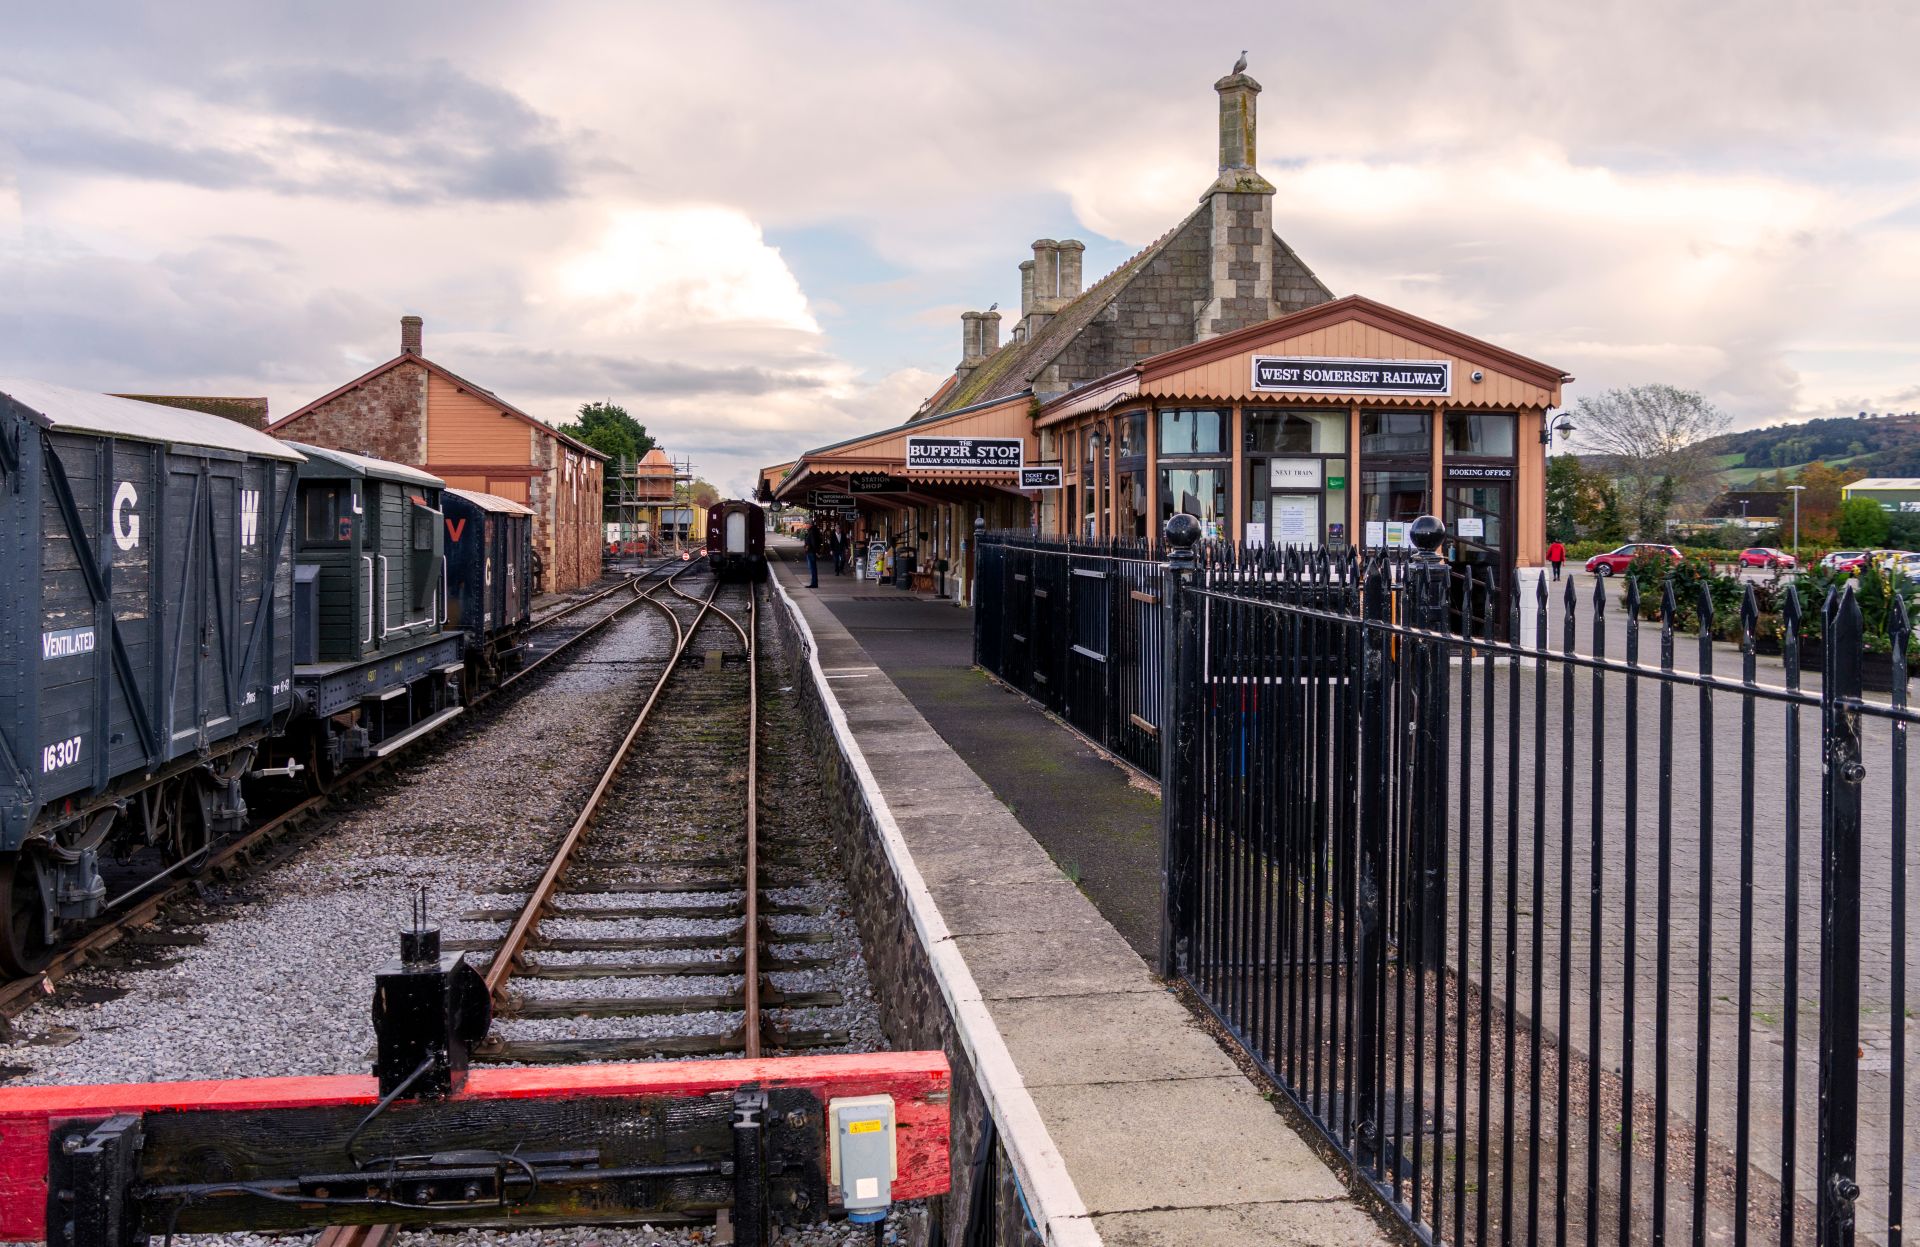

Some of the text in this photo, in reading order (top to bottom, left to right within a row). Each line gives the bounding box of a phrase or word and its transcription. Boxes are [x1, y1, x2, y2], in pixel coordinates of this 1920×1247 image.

[1261, 368, 1442, 385] WEST SOMERSET RAILWAY
[910, 445, 1020, 458] BUFFER STOP
[1449, 468, 1511, 477] BOOKING OFFICE
[113, 482, 259, 551] G W
[445, 518, 466, 542] V
[485, 556, 491, 587] G
[43, 736, 82, 773] 16307
